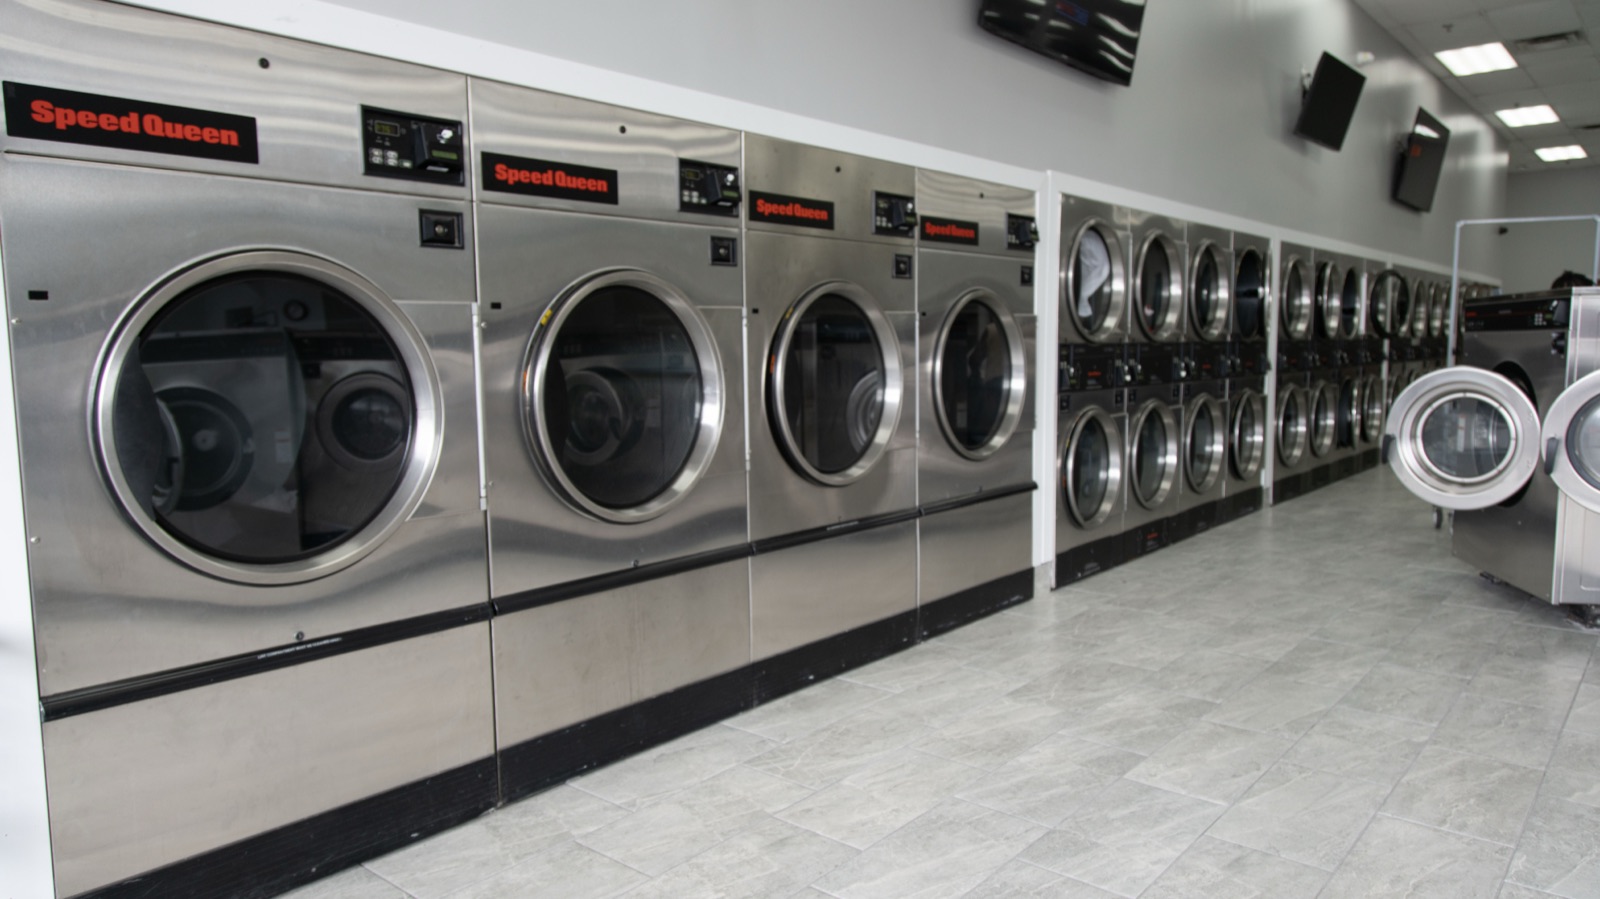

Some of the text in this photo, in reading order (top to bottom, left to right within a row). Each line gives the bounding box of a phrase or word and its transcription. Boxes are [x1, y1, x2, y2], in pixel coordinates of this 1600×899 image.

[30, 100, 240, 147] Speed Queen
[494, 163, 609, 193] Speed Queen
[756, 198, 829, 221] Speed Queen
